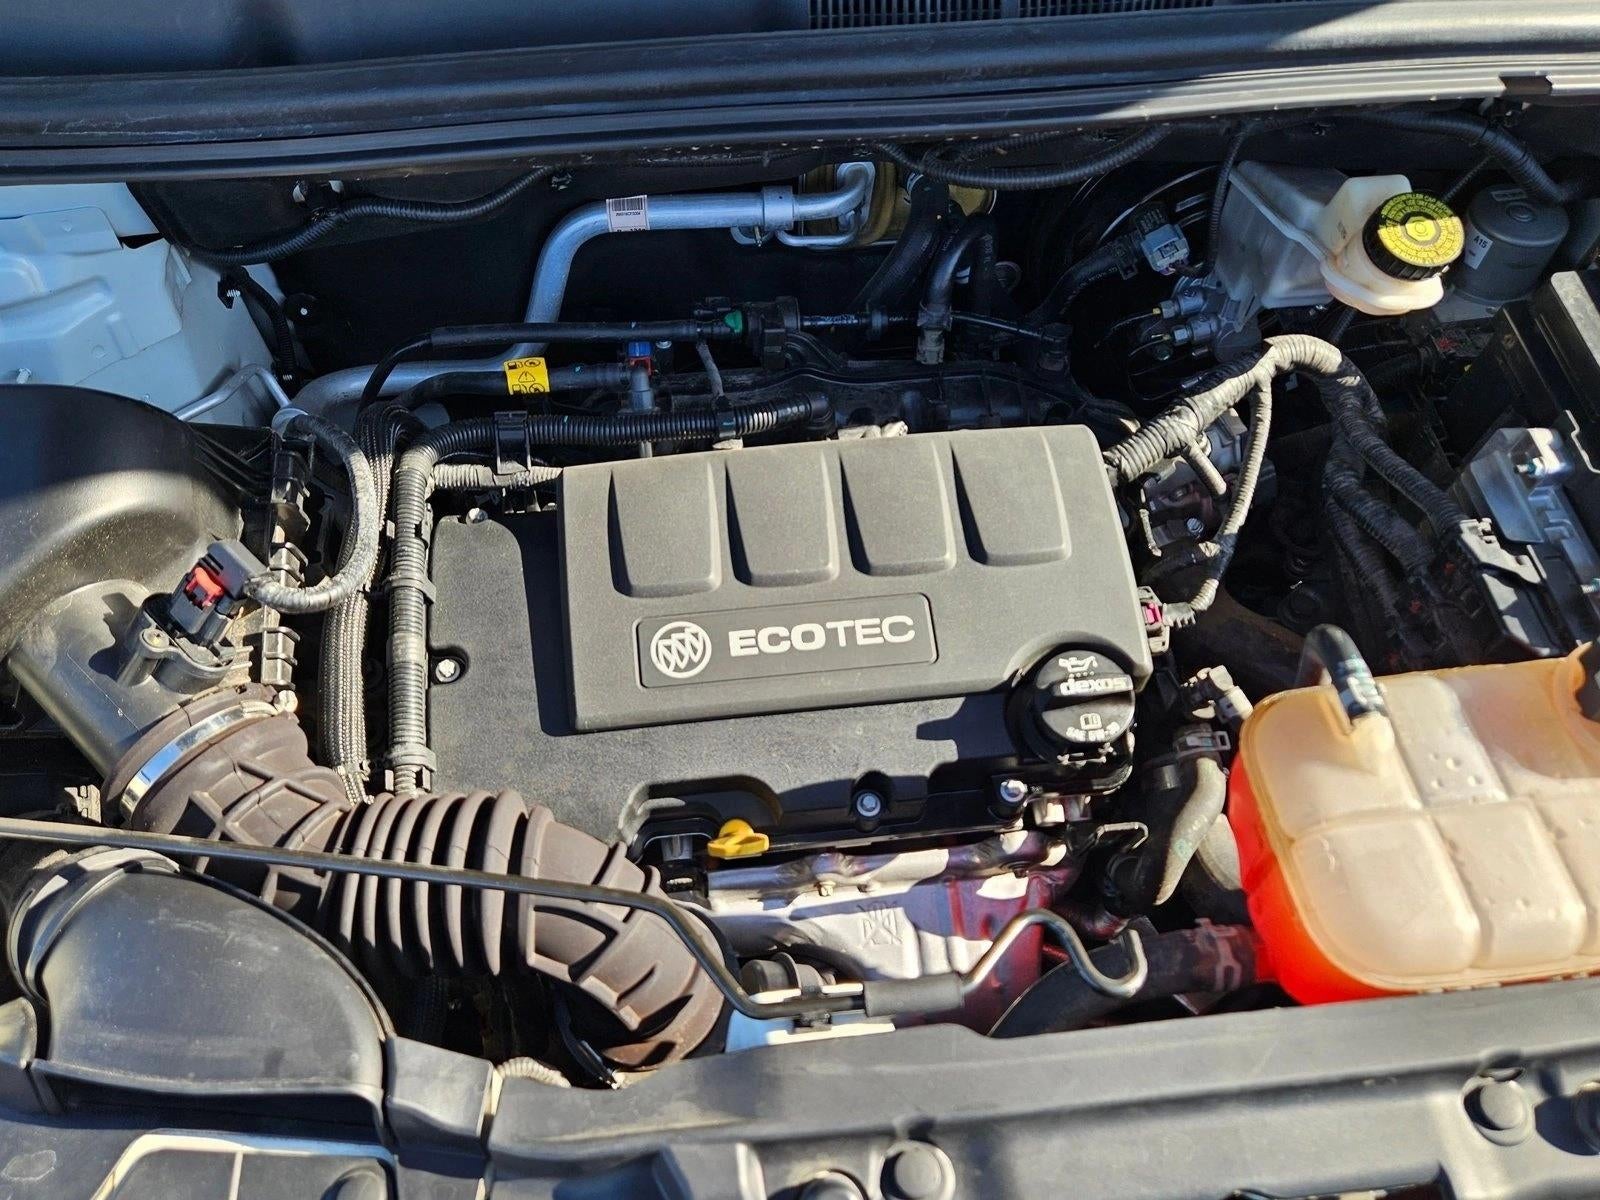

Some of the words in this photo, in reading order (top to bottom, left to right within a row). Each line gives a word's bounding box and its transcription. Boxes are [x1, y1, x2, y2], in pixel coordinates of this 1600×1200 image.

[1473, 235, 1488, 249] A15
[728, 615, 916, 657] ECOTEC
[1060, 677, 1128, 696] dexos
